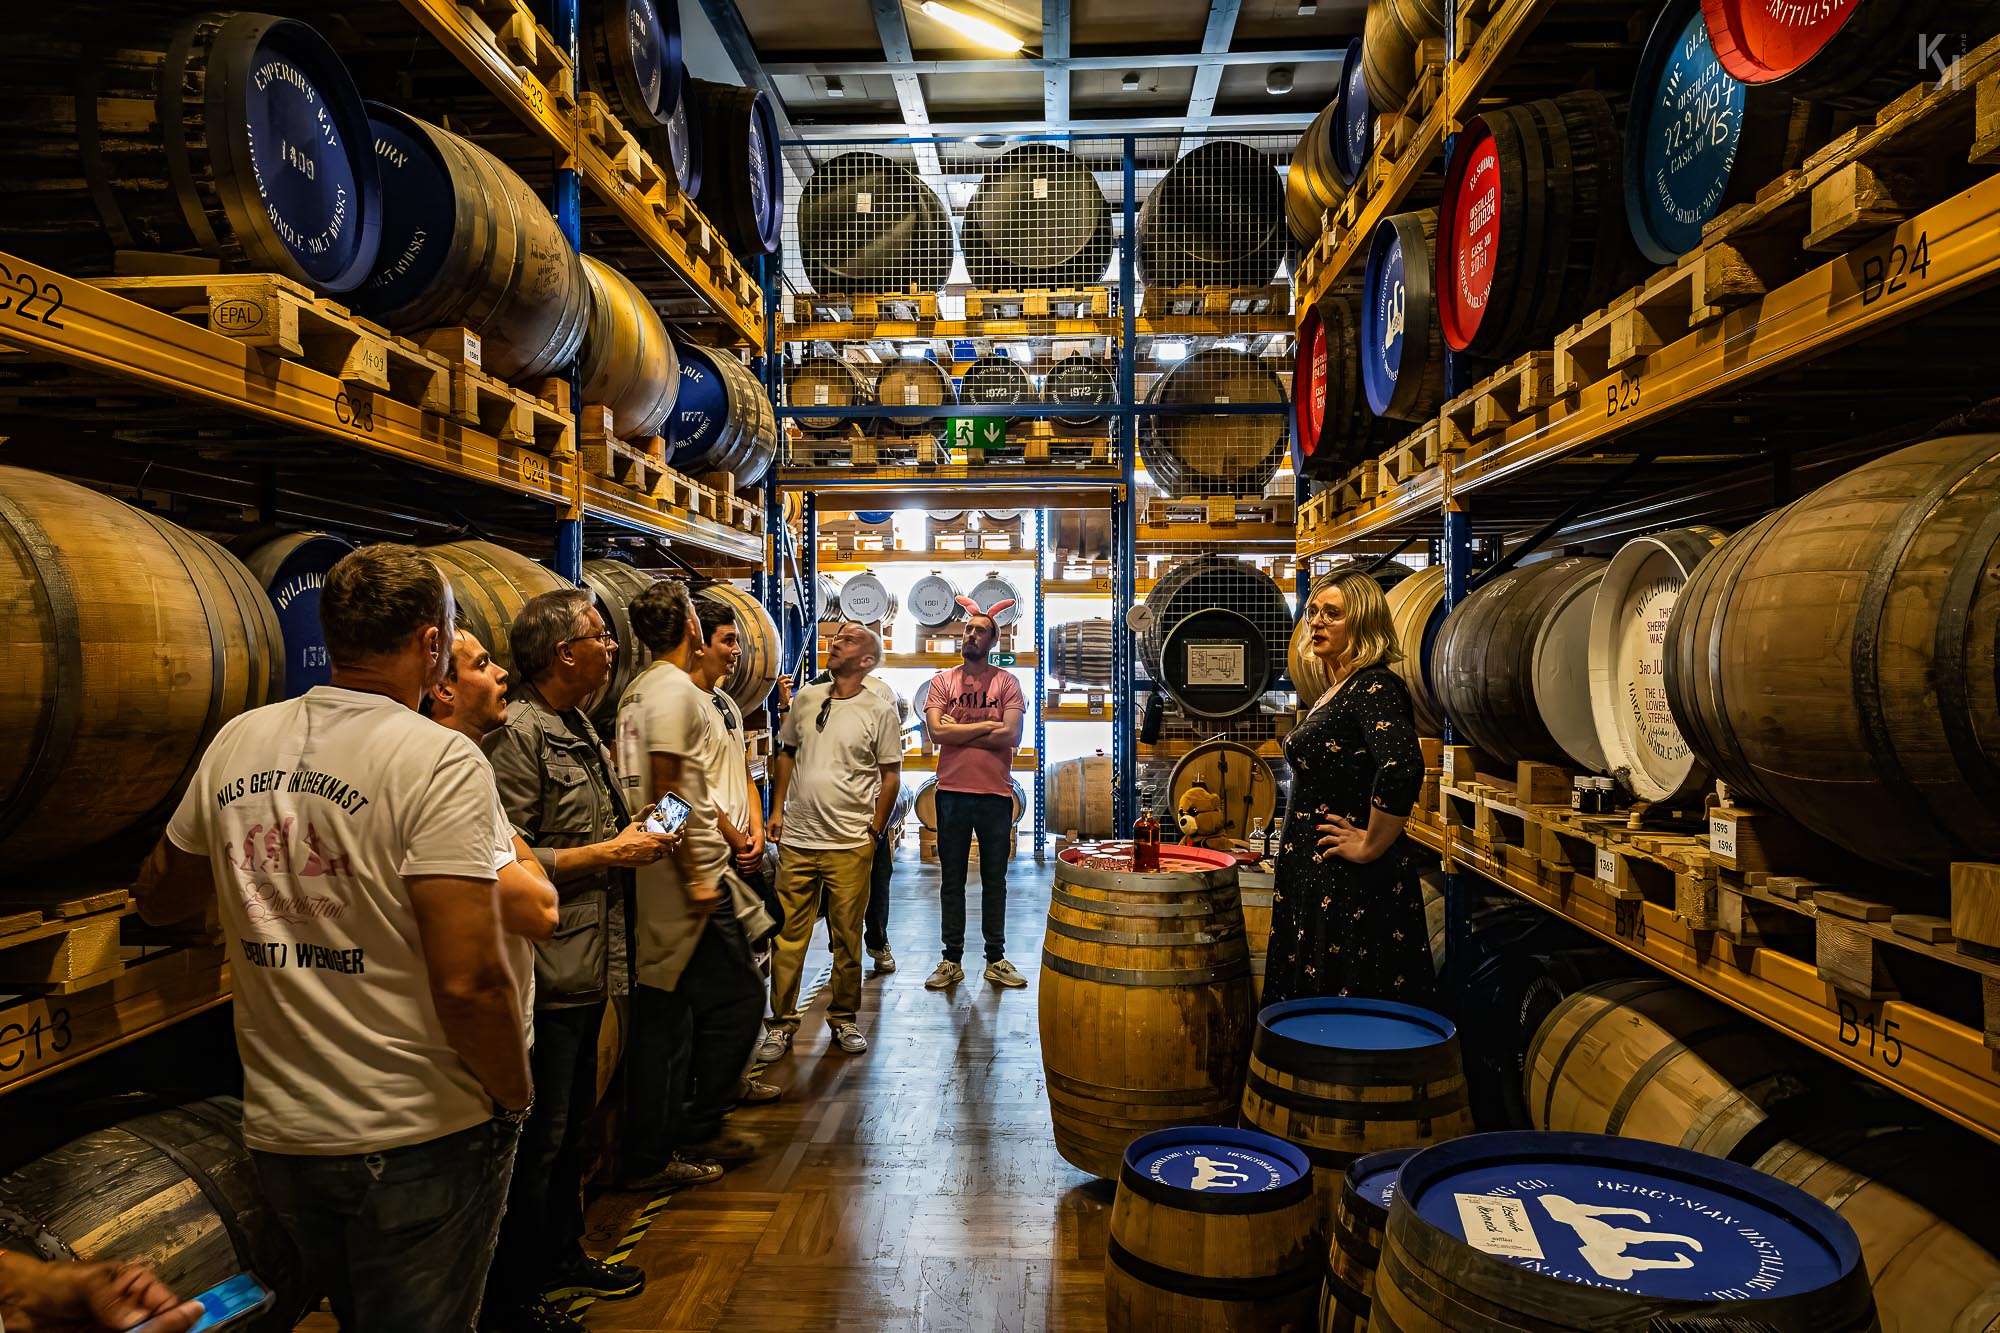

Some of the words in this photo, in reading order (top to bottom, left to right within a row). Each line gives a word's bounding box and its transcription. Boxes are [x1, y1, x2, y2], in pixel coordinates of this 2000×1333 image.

[1685, 25, 1708, 60] GLE
[520, 75, 544, 115] C33
[1677, 60, 1720, 110] DISTILLED
[1863, 231, 1931, 301] B24
[219, 306, 258, 325] EPAL
[334, 391, 375, 433] C23
[1607, 374, 1642, 418] B23
[522, 456, 546, 485] C24
[1649, 633, 1663, 644] WAS
[1645, 688, 1656, 700] THE
[1645, 700, 1666, 712] LOWER
[217, 778, 245, 811] NILS
[250, 770, 287, 794] GEHT
[1713, 822, 1728, 834] 1595
[1717, 840, 1733, 852] 1596
[1599, 858, 1613, 873] 1363
[1614, 899, 1646, 947] B14
[0, 1008, 72, 1071] C13
[1838, 999, 1902, 1068] B15
[1596, 1179, 1740, 1226] HERCYNIAN
